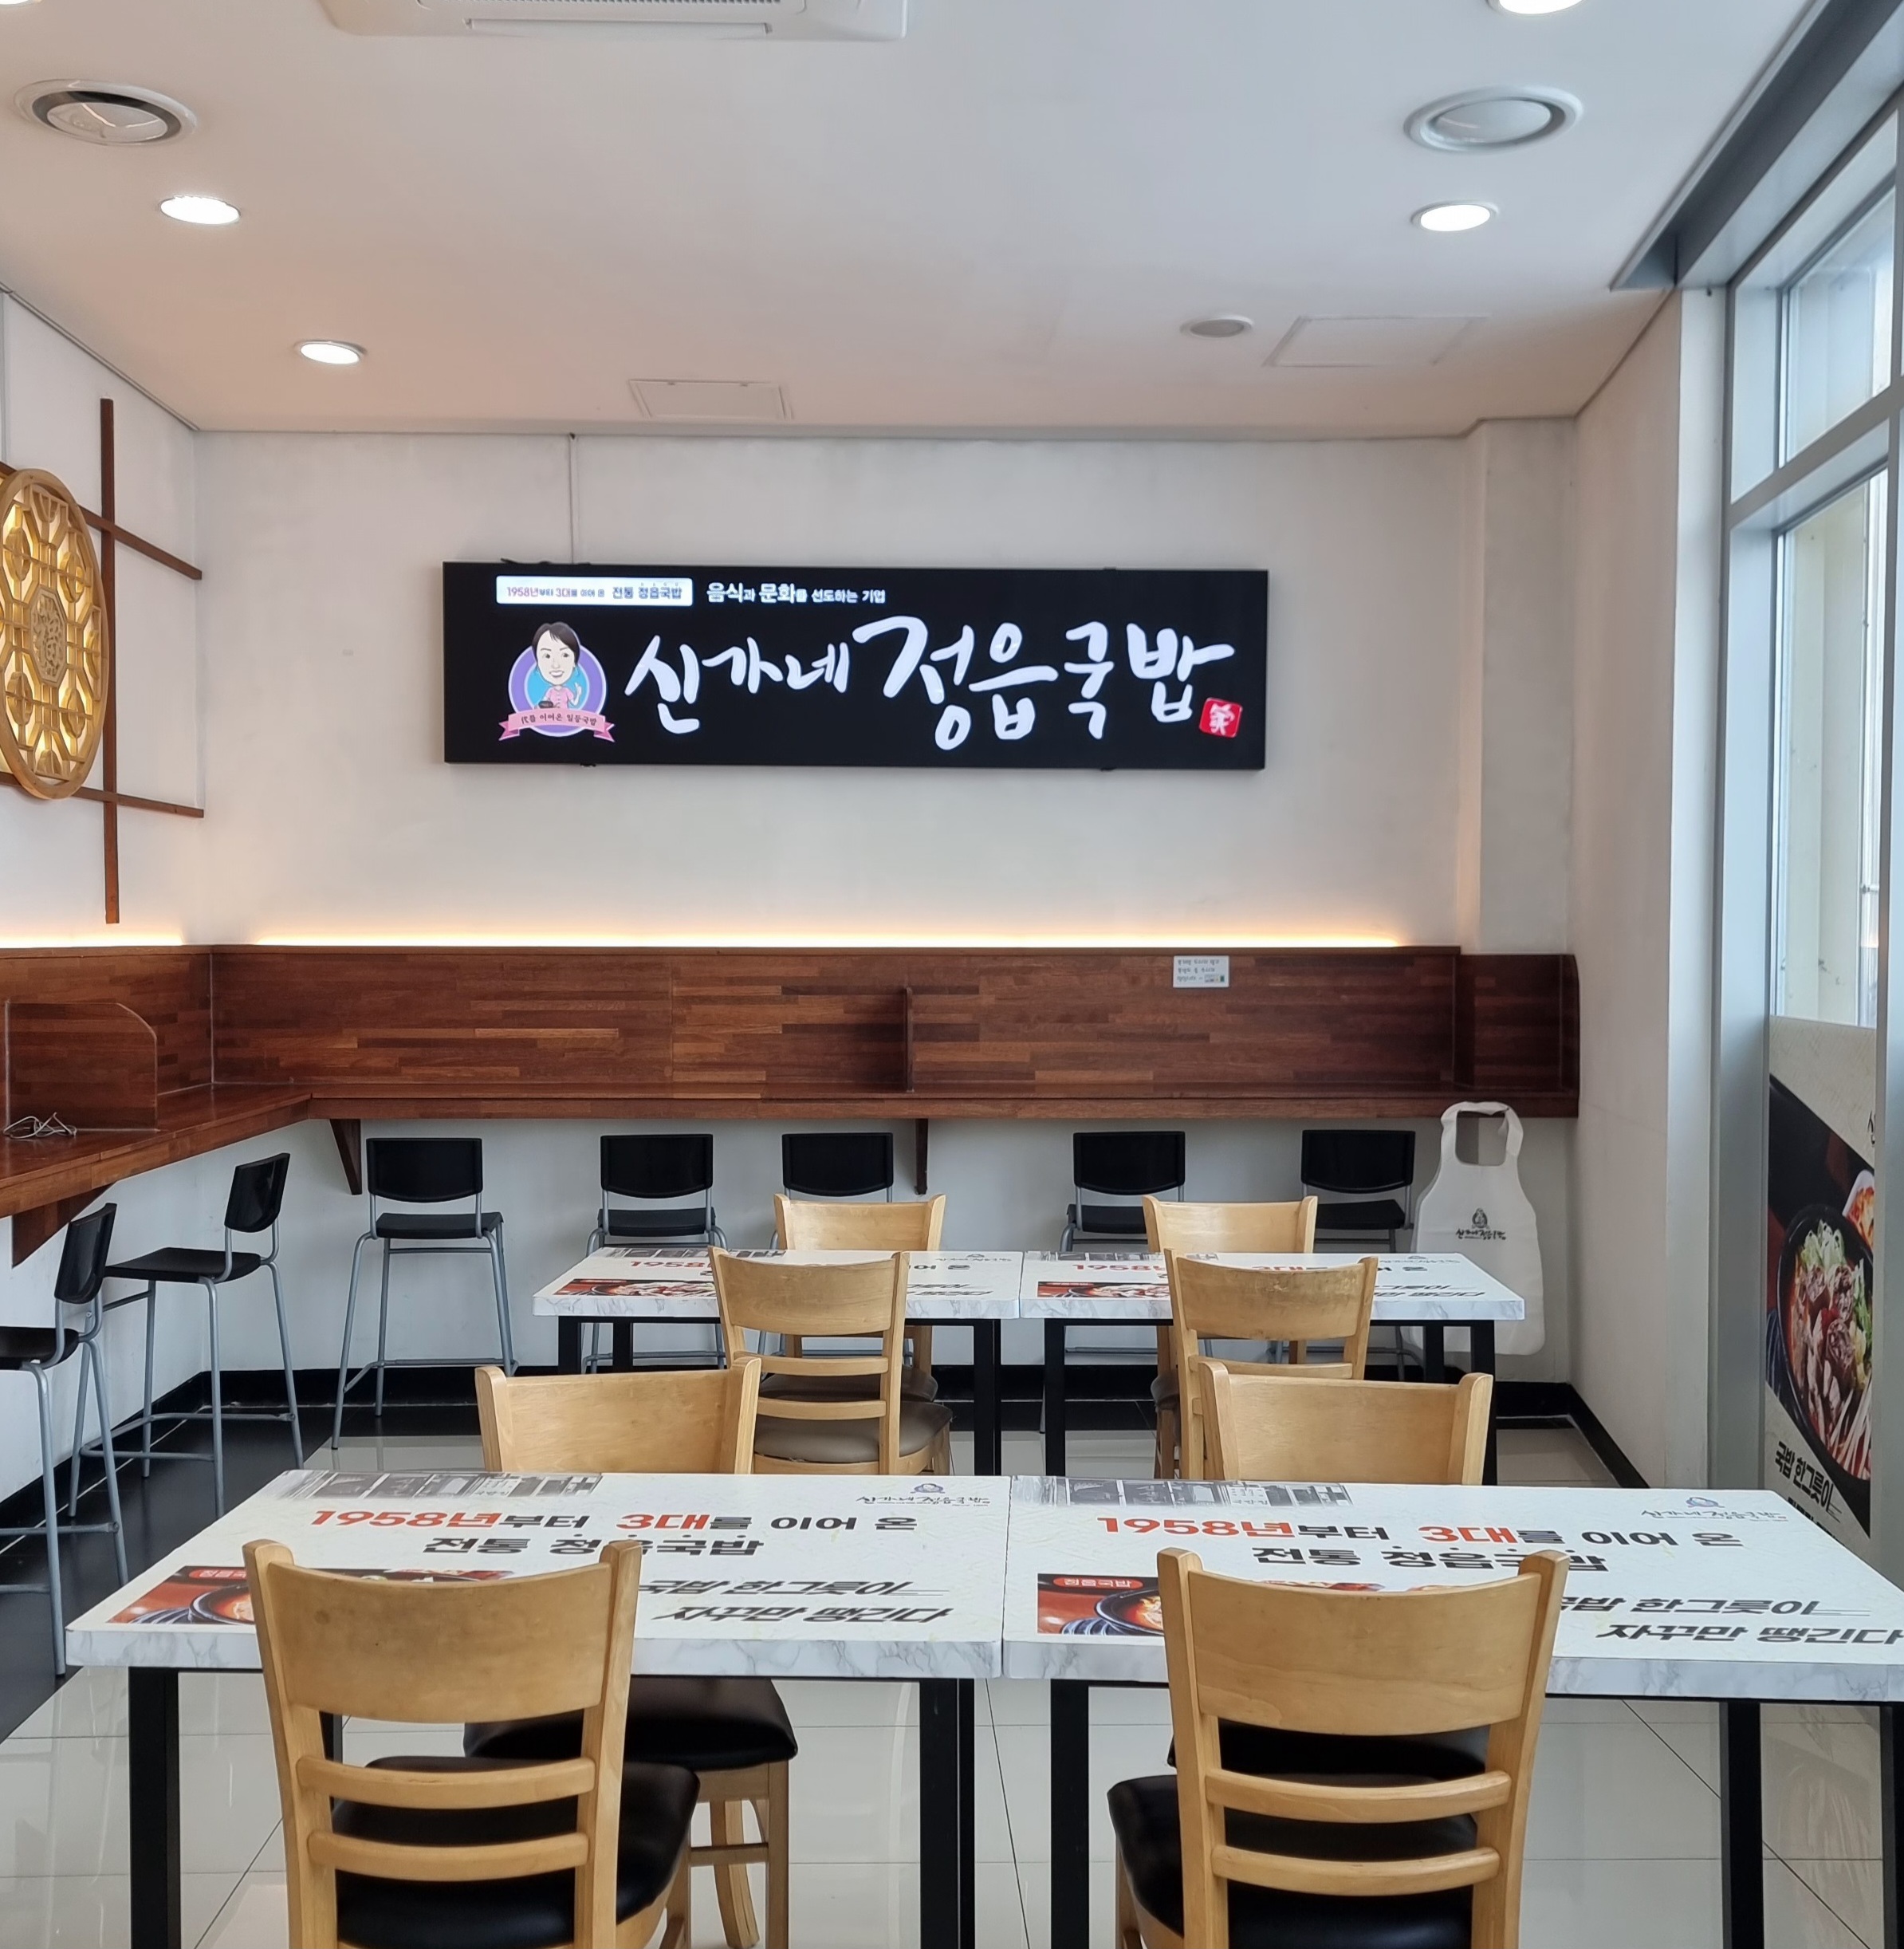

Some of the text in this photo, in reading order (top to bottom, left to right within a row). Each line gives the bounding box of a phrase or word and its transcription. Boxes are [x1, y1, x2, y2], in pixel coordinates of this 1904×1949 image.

[706, 582, 886, 604] 음식과 문화를 선도하는 기업
[1775, 1440, 1835, 1512] 국밥 한그릇이
[311, 1510, 918, 1531] 1958년부터 3대를 이어 온
[1097, 1517, 1744, 1547] 1958년부터 3대를 이어 온
[422, 1538, 531, 1554] 전통
[1251, 1547, 1362, 1566] 전통
[720, 1580, 914, 1596] 한그릇이
[651, 1606, 954, 1624] 자꾸만 땡긴다
[1631, 1597, 1820, 1616] 한그릇이
[1595, 1624, 1904, 1645] 자꾸만 땡긴다
